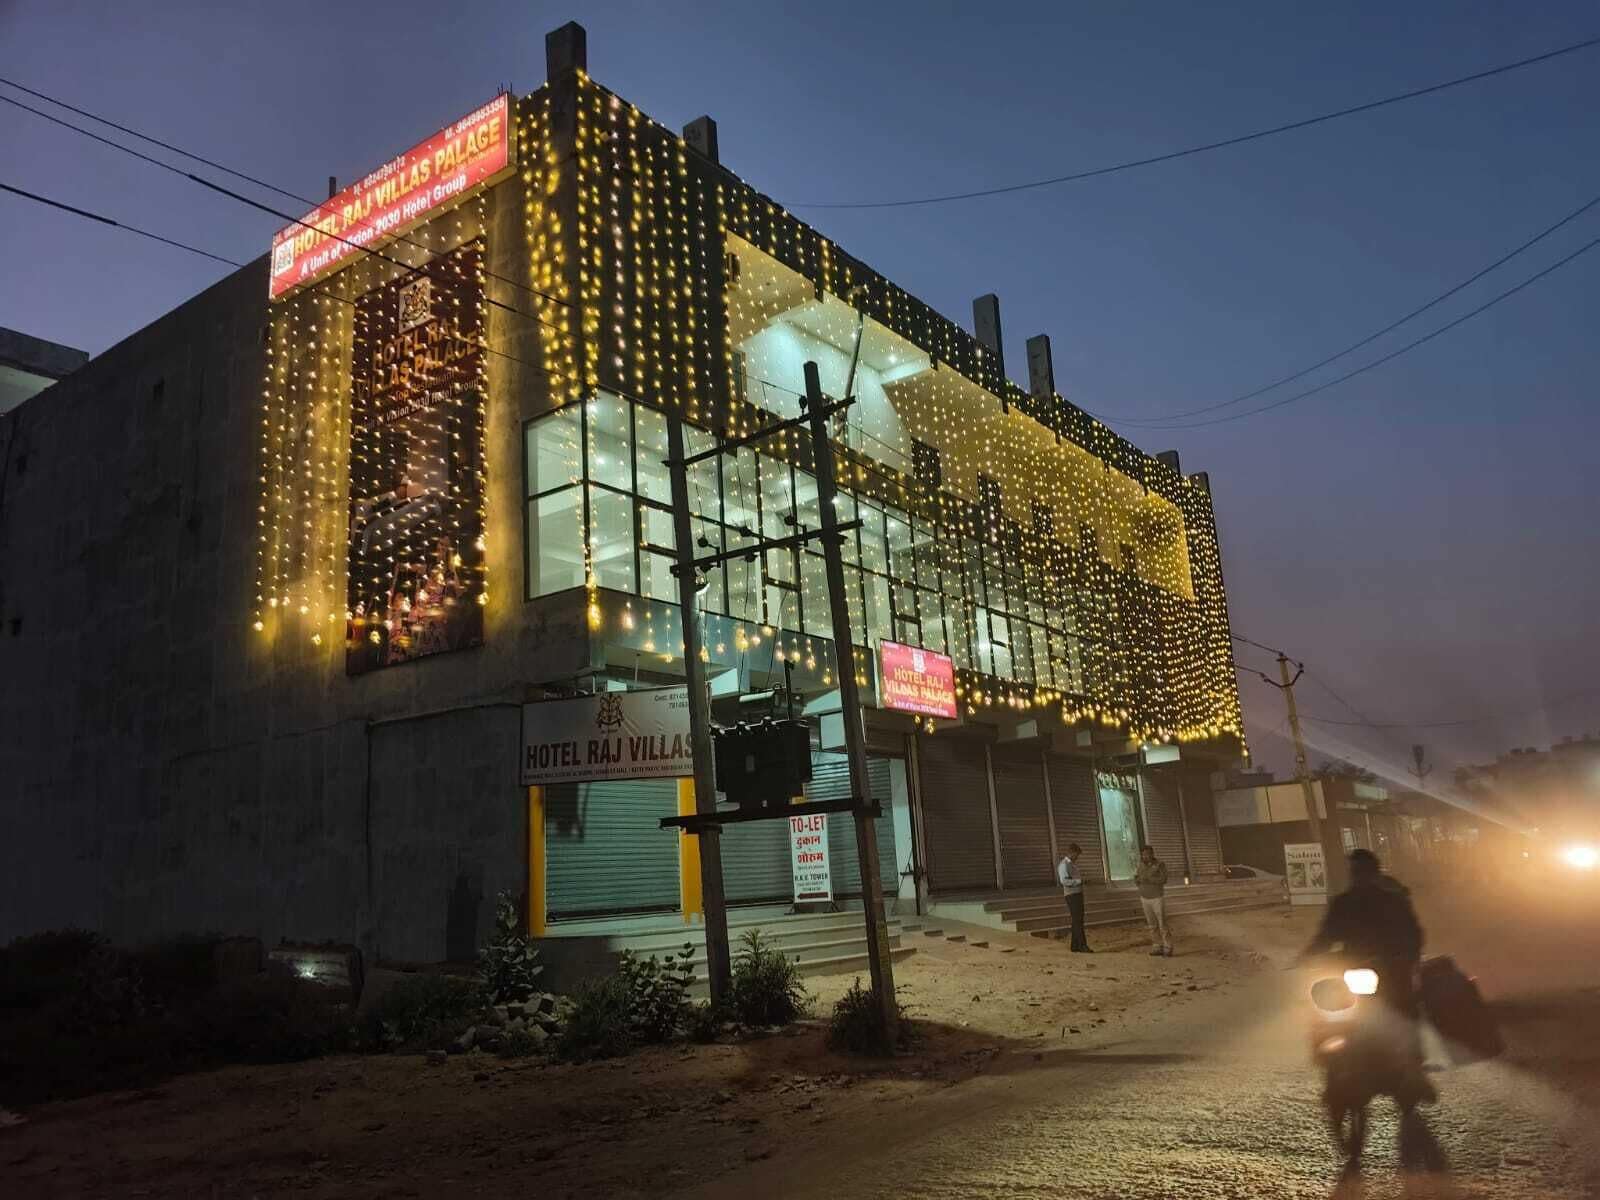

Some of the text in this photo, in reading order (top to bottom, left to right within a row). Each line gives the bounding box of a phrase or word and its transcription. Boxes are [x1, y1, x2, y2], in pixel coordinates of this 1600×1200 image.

[294, 213, 340, 257] HOTEL
[342, 191, 372, 230] RAJ
[375, 158, 431, 208] VILLAS
[435, 117, 500, 176] PALACE
[301, 262, 308, 277] A
[309, 247, 330, 271] Unit
[375, 208, 401, 234] 2030
[403, 190, 432, 218] Hotel
[433, 174, 467, 202] Group
[373, 330, 424, 371] HOTEL
[894, 667, 925, 686] HOTEL
[527, 733, 693, 769] HOTEL RAJ VILLAS
[791, 815, 825, 833] TO-LET
[796, 835, 821, 849] दुकान
